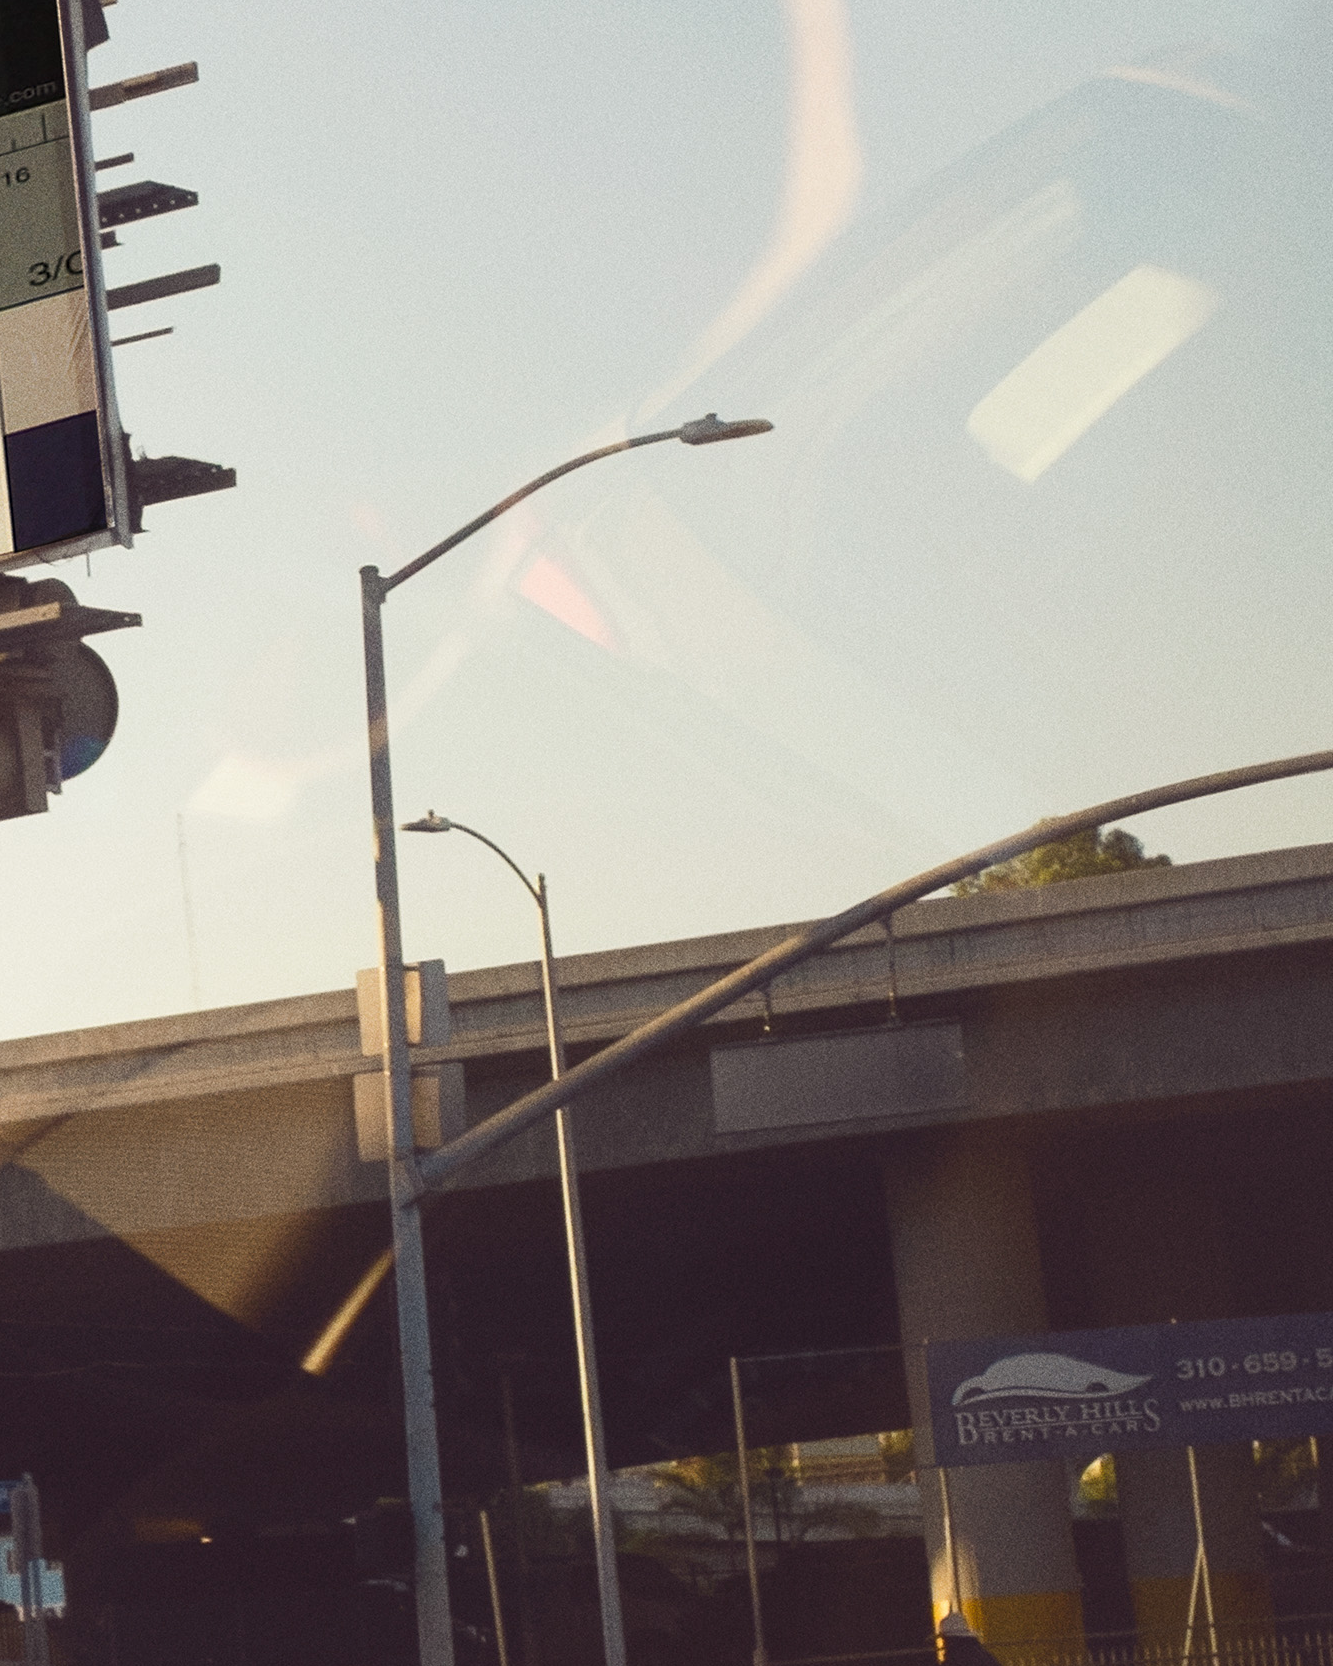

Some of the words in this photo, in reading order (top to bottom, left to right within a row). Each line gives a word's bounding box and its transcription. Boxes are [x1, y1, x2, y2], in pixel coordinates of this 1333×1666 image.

[0, 166, 32, 187] 16
[1178, 1385, 1333, 1413] www.BHRENTAC
[955, 1404, 1072, 1446] BEVERLY
[1078, 1397, 1162, 1433] HILLS
